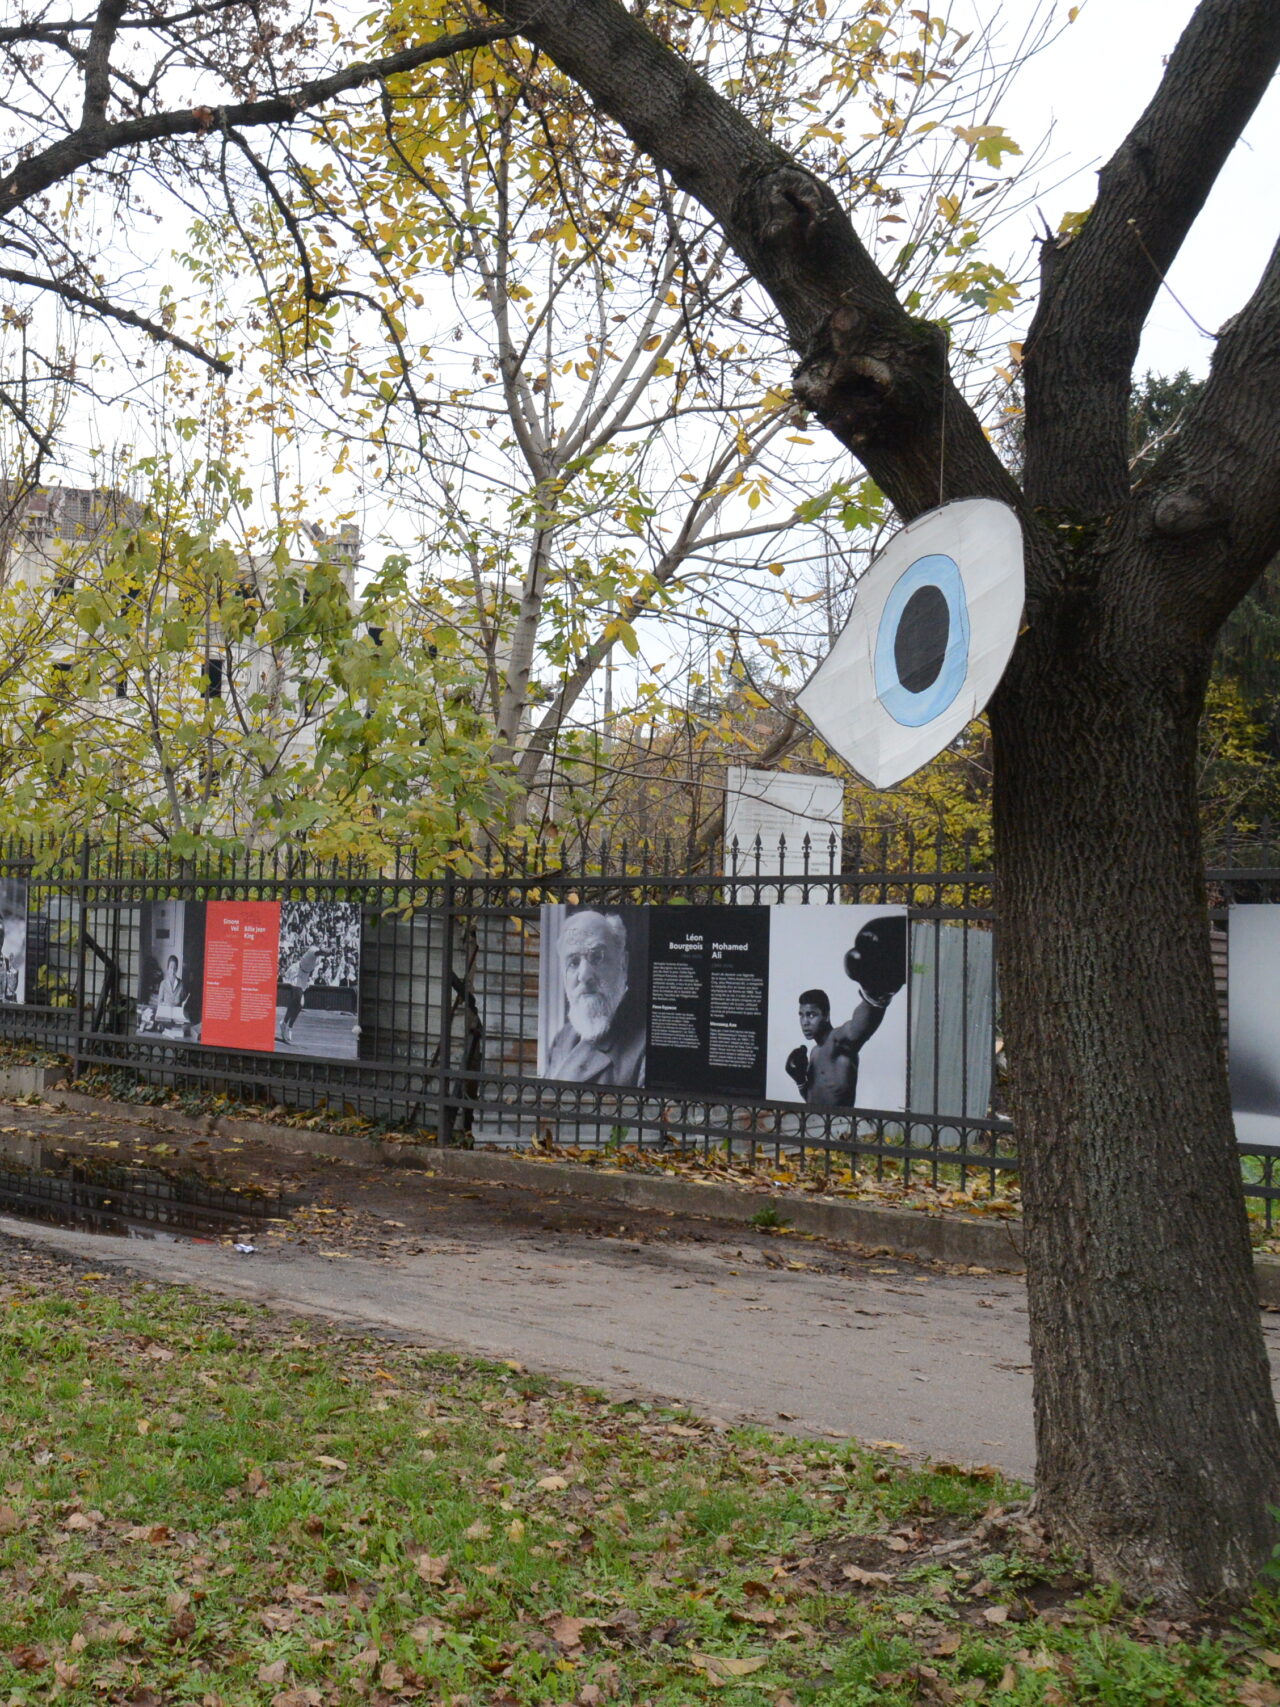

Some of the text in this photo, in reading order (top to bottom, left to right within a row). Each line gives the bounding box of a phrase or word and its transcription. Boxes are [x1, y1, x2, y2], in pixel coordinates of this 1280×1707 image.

[686, 933, 703, 941] Léon
[669, 942, 703, 952] Bourgeois
[711, 942, 749, 951] Mohamed
[711, 951, 723, 960] Ali
